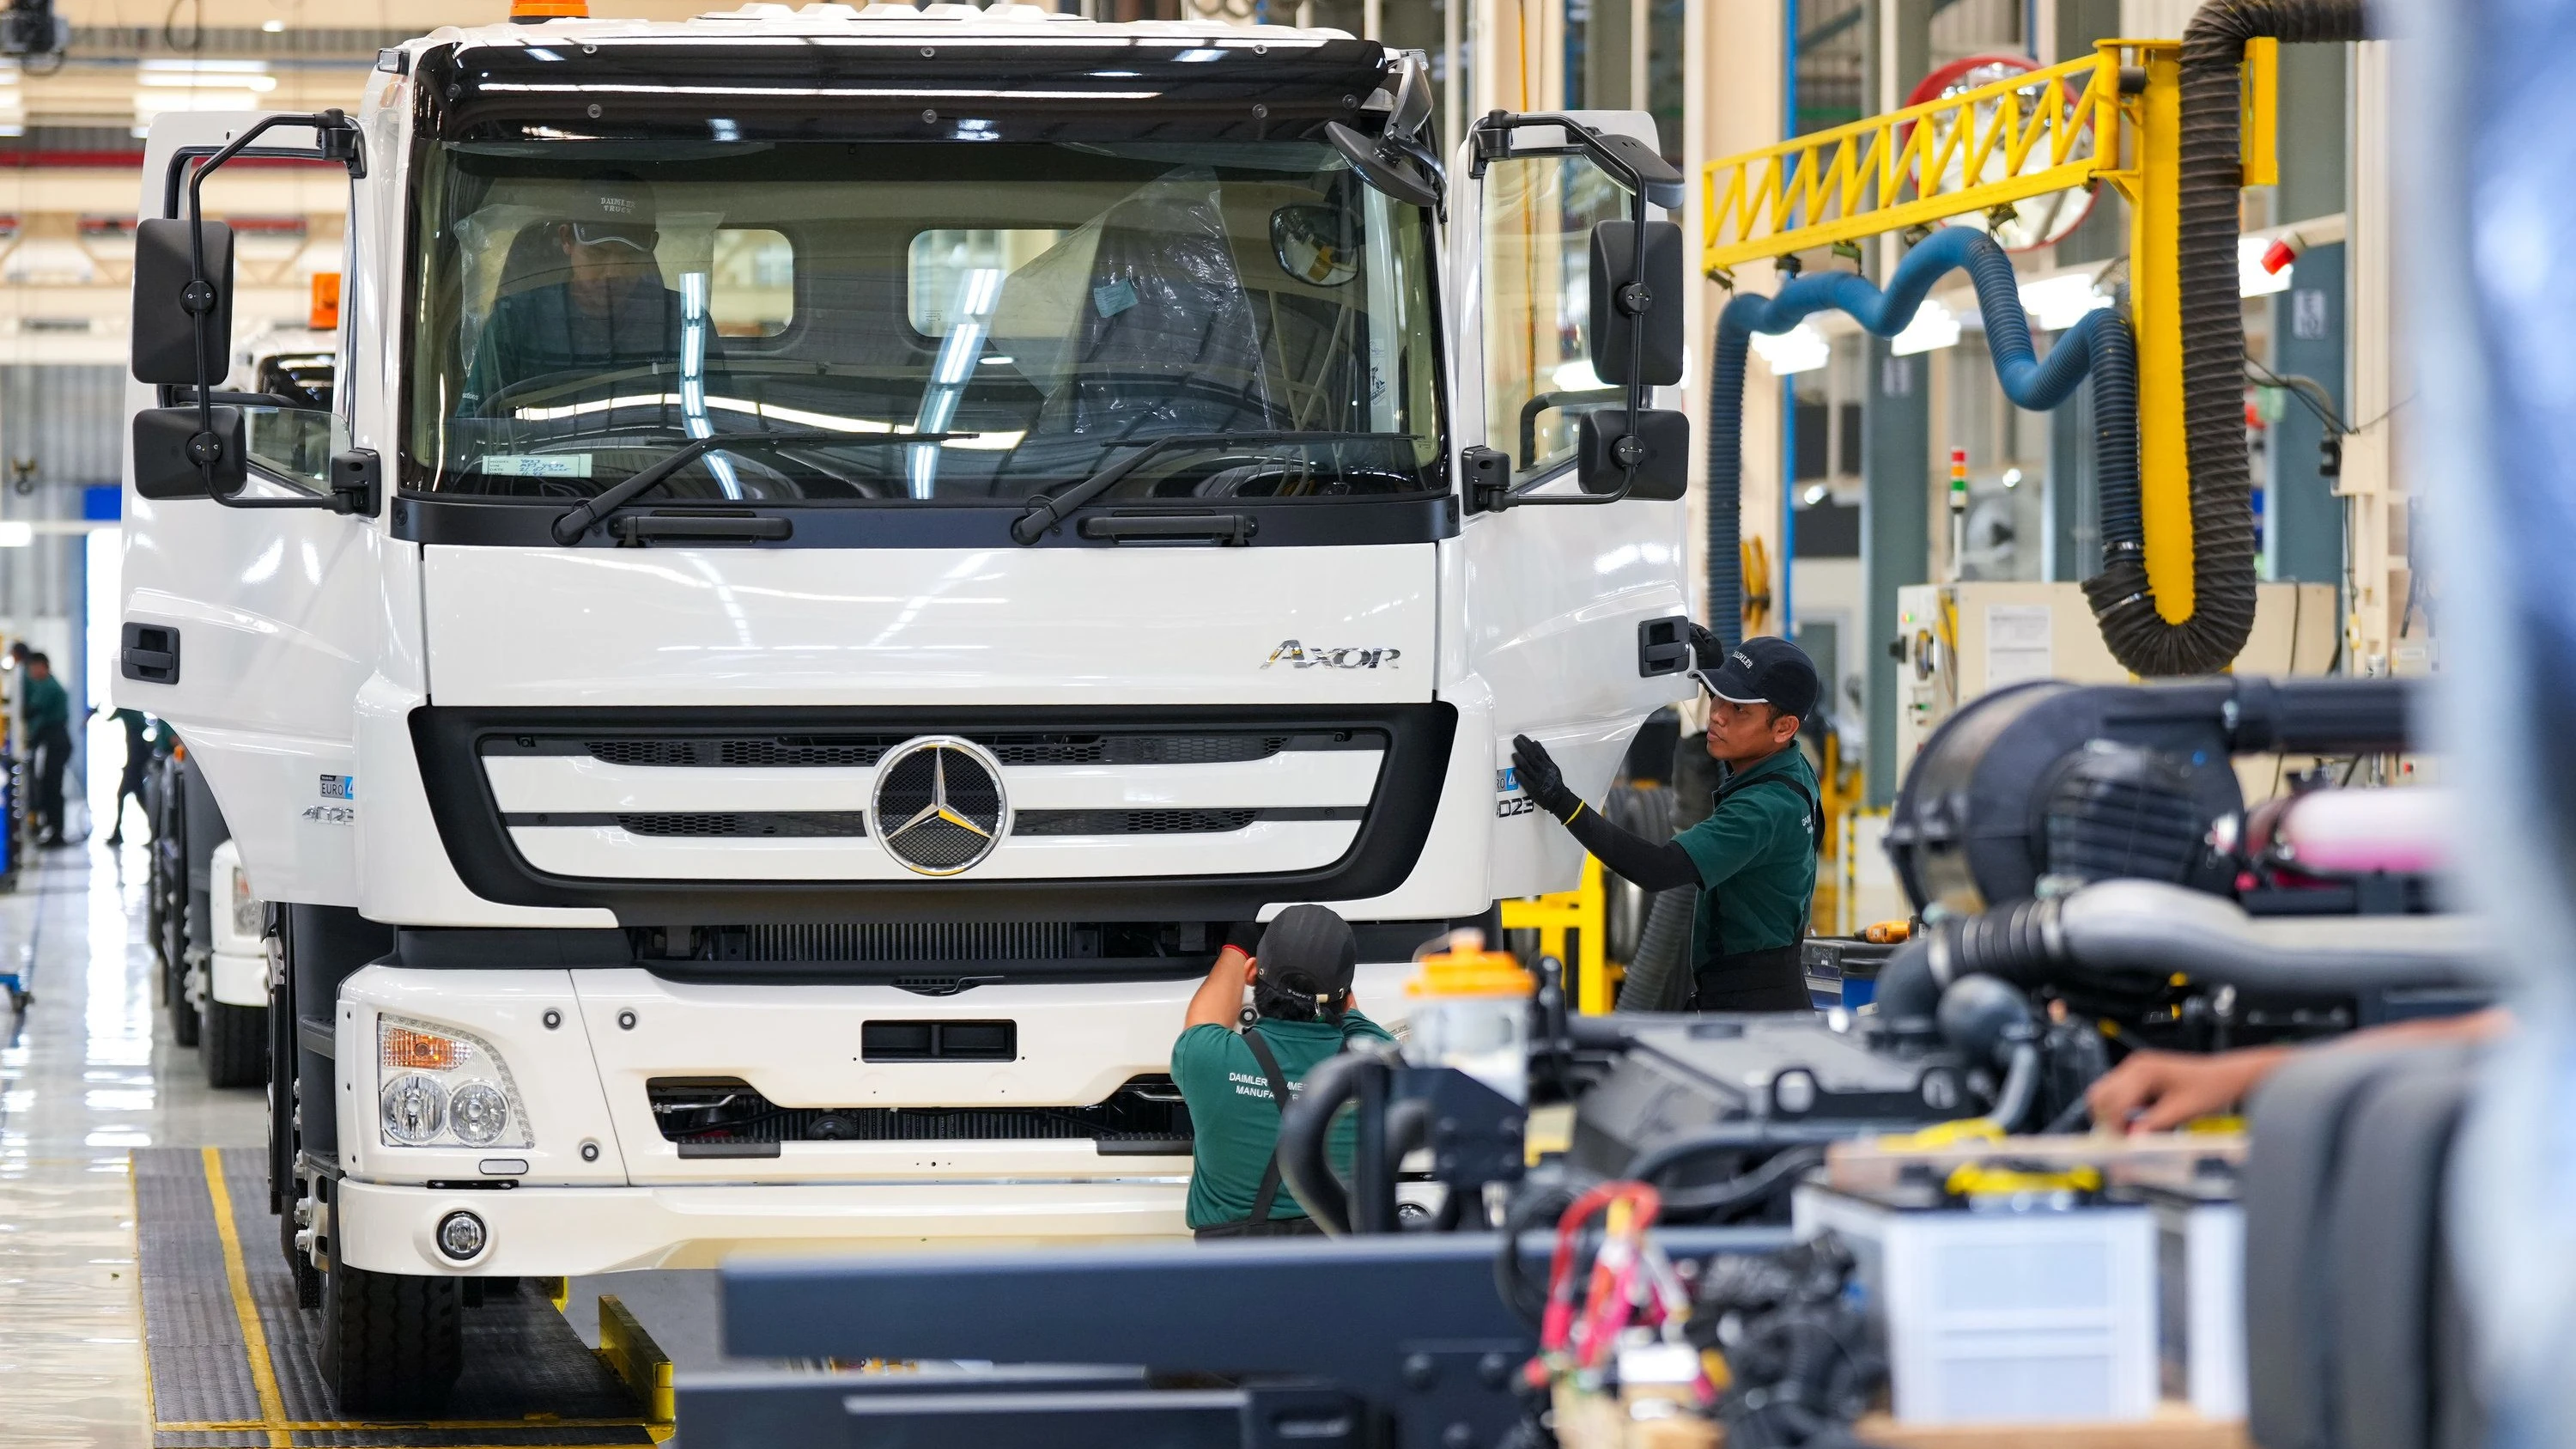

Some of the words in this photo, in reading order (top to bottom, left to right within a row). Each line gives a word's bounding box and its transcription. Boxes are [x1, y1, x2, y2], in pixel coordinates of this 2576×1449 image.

[603, 204, 632, 215] TRUCK
[1259, 638, 1401, 669] AXOR
[321, 782, 343, 795] EURO
[1497, 796, 1534, 818] 023
[1229, 1072, 1268, 1087] DAIMLER
